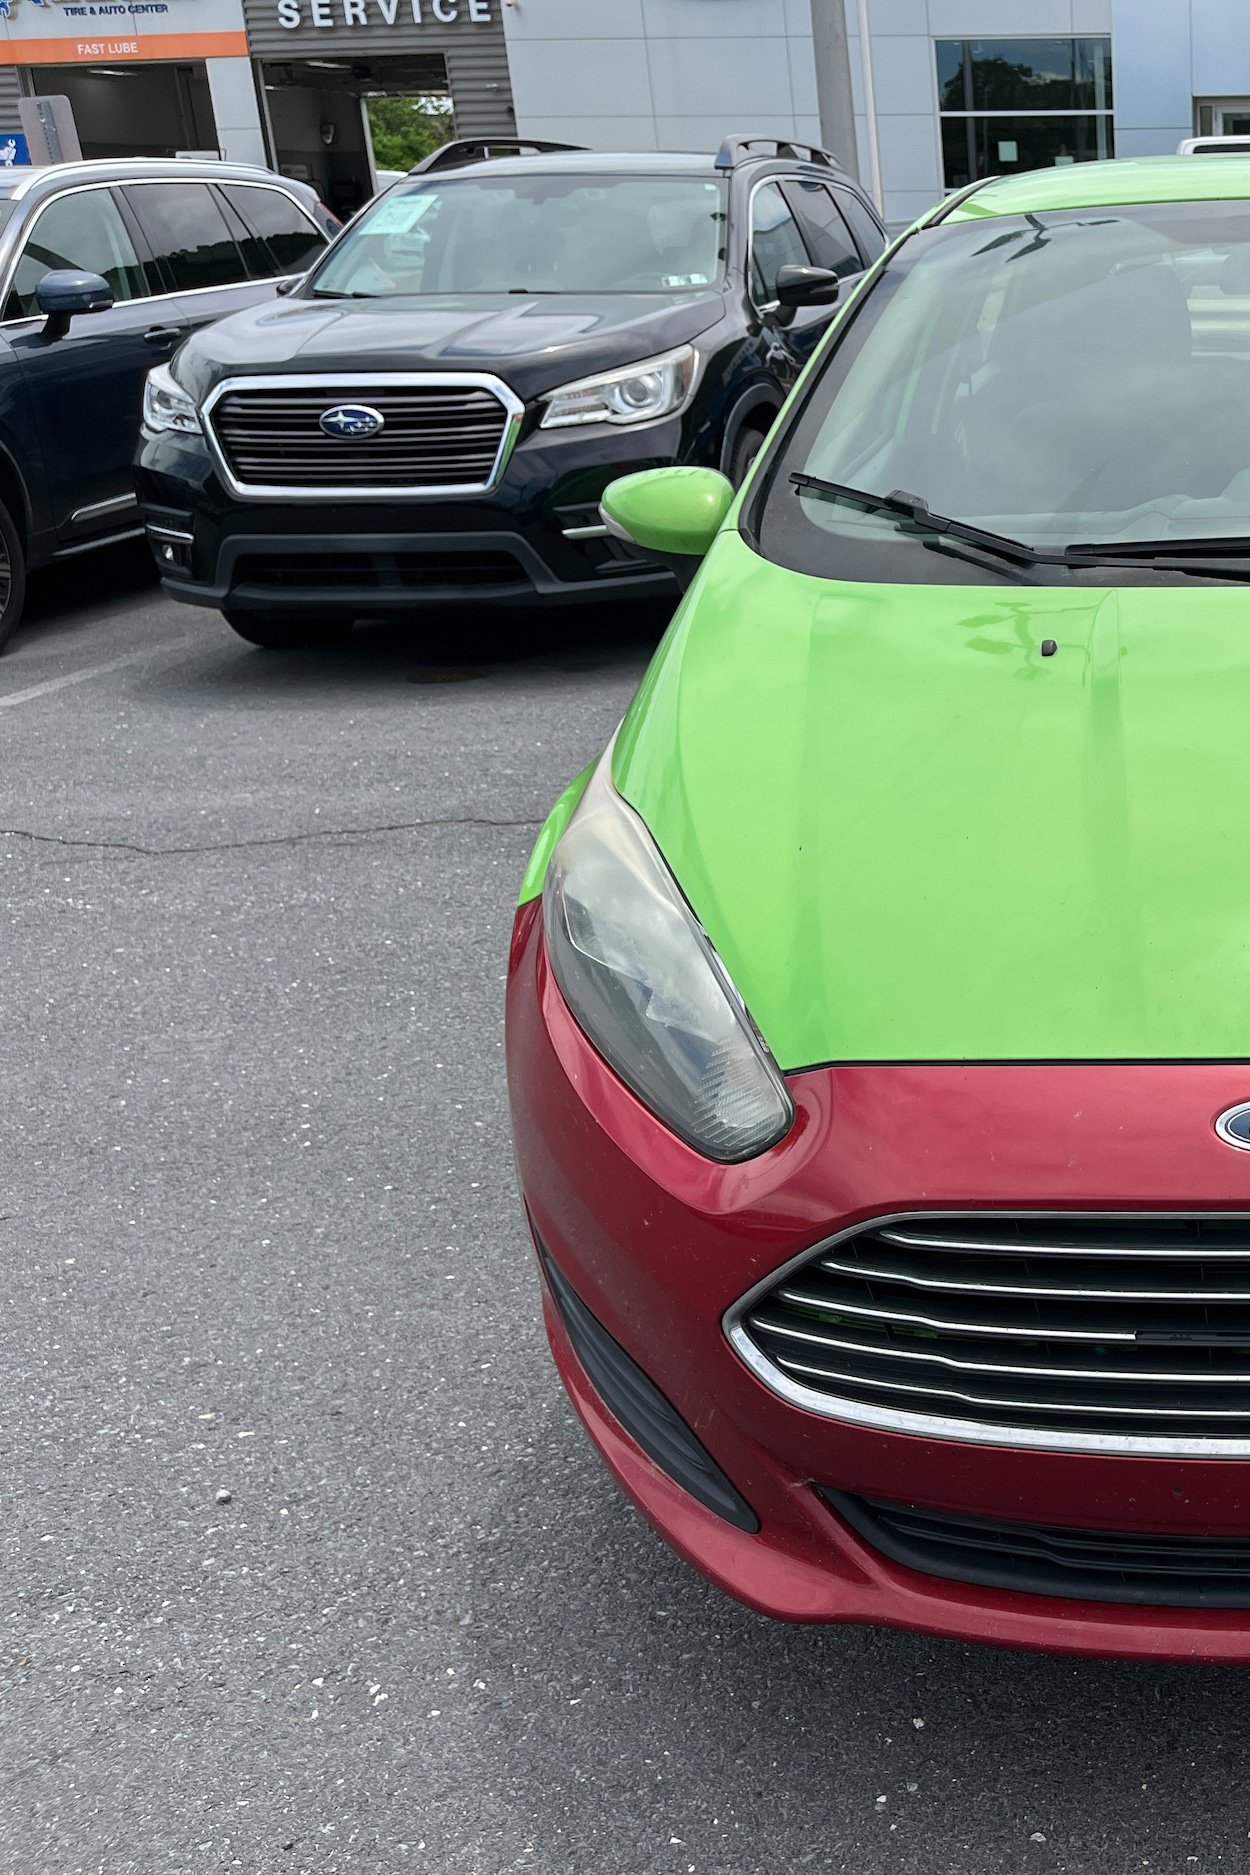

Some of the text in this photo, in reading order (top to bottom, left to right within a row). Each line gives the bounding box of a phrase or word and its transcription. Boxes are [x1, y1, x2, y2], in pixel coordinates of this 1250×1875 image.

[63, 4, 169, 17] TIRE & AUTO CENTER
[277, 0, 491, 28] SERVICE
[77, 42, 138, 56] FAST LUBE
